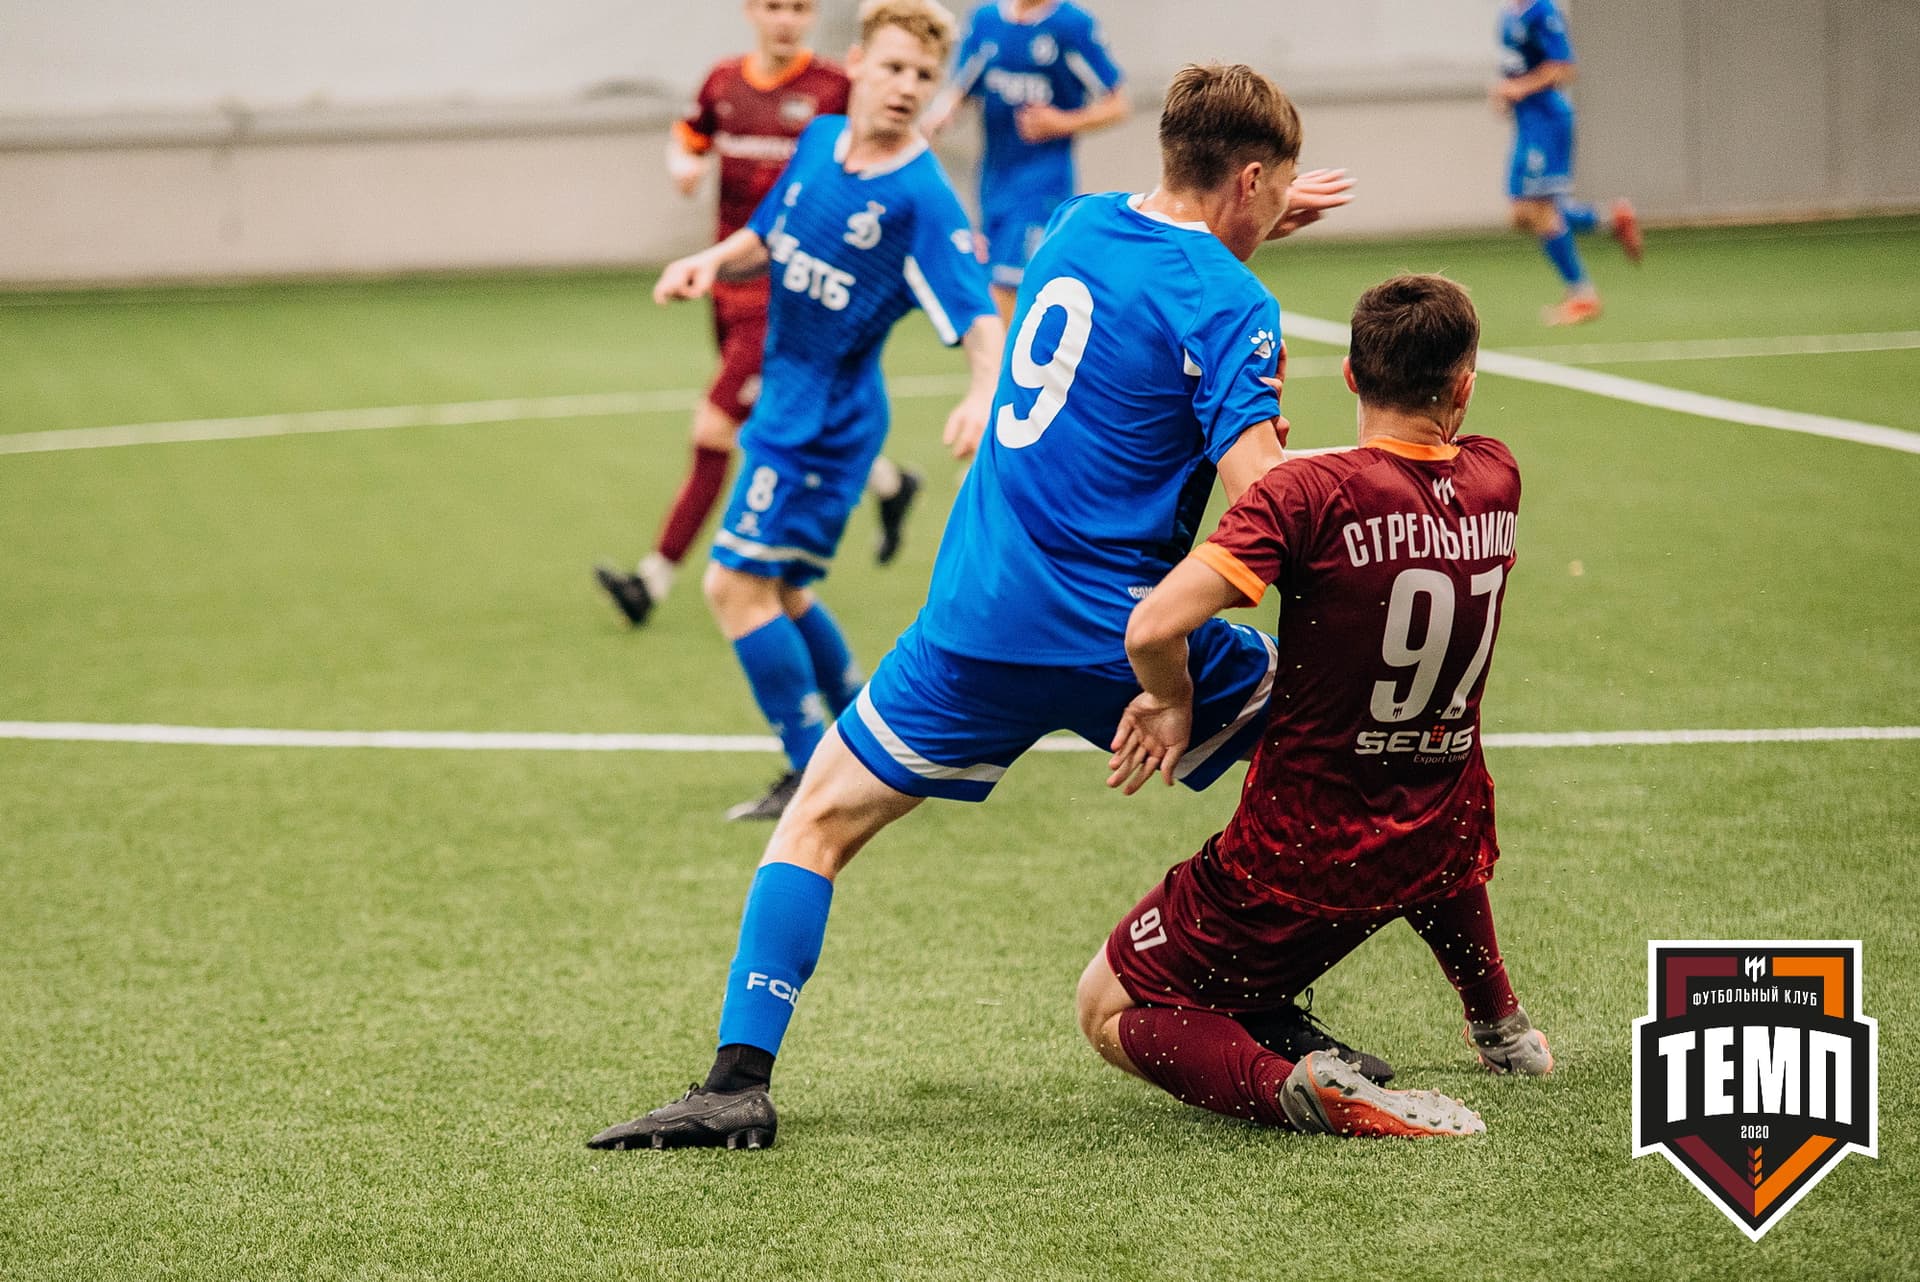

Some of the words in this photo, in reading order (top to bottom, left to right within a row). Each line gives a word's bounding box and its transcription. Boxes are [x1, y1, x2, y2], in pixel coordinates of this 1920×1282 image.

[996, 276, 1094, 449] 9
[746, 466, 778, 513] 8
[1342, 510, 1518, 567] СТРЕЛЬНИКО
[1370, 564, 1504, 723] 97
[1413, 753, 1446, 765] Export
[1130, 906, 1168, 952] 97
